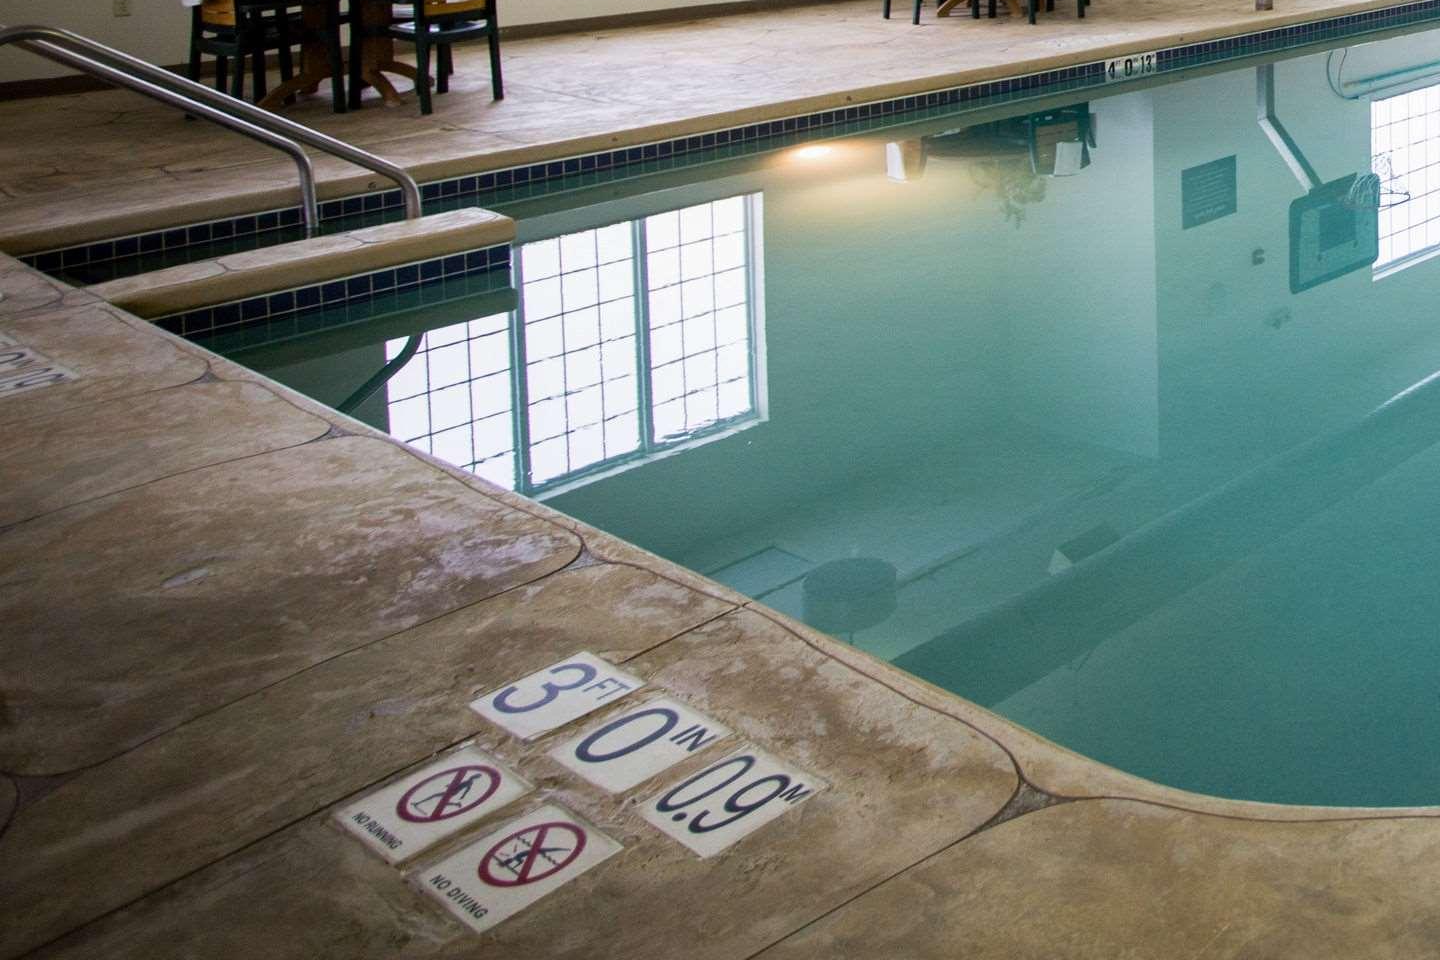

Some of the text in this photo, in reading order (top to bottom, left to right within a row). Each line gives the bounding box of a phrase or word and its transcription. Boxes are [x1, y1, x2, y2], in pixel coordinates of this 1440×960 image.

[352, 811, 403, 850] NO RUNNING
[429, 874, 489, 919] NO DIVING
